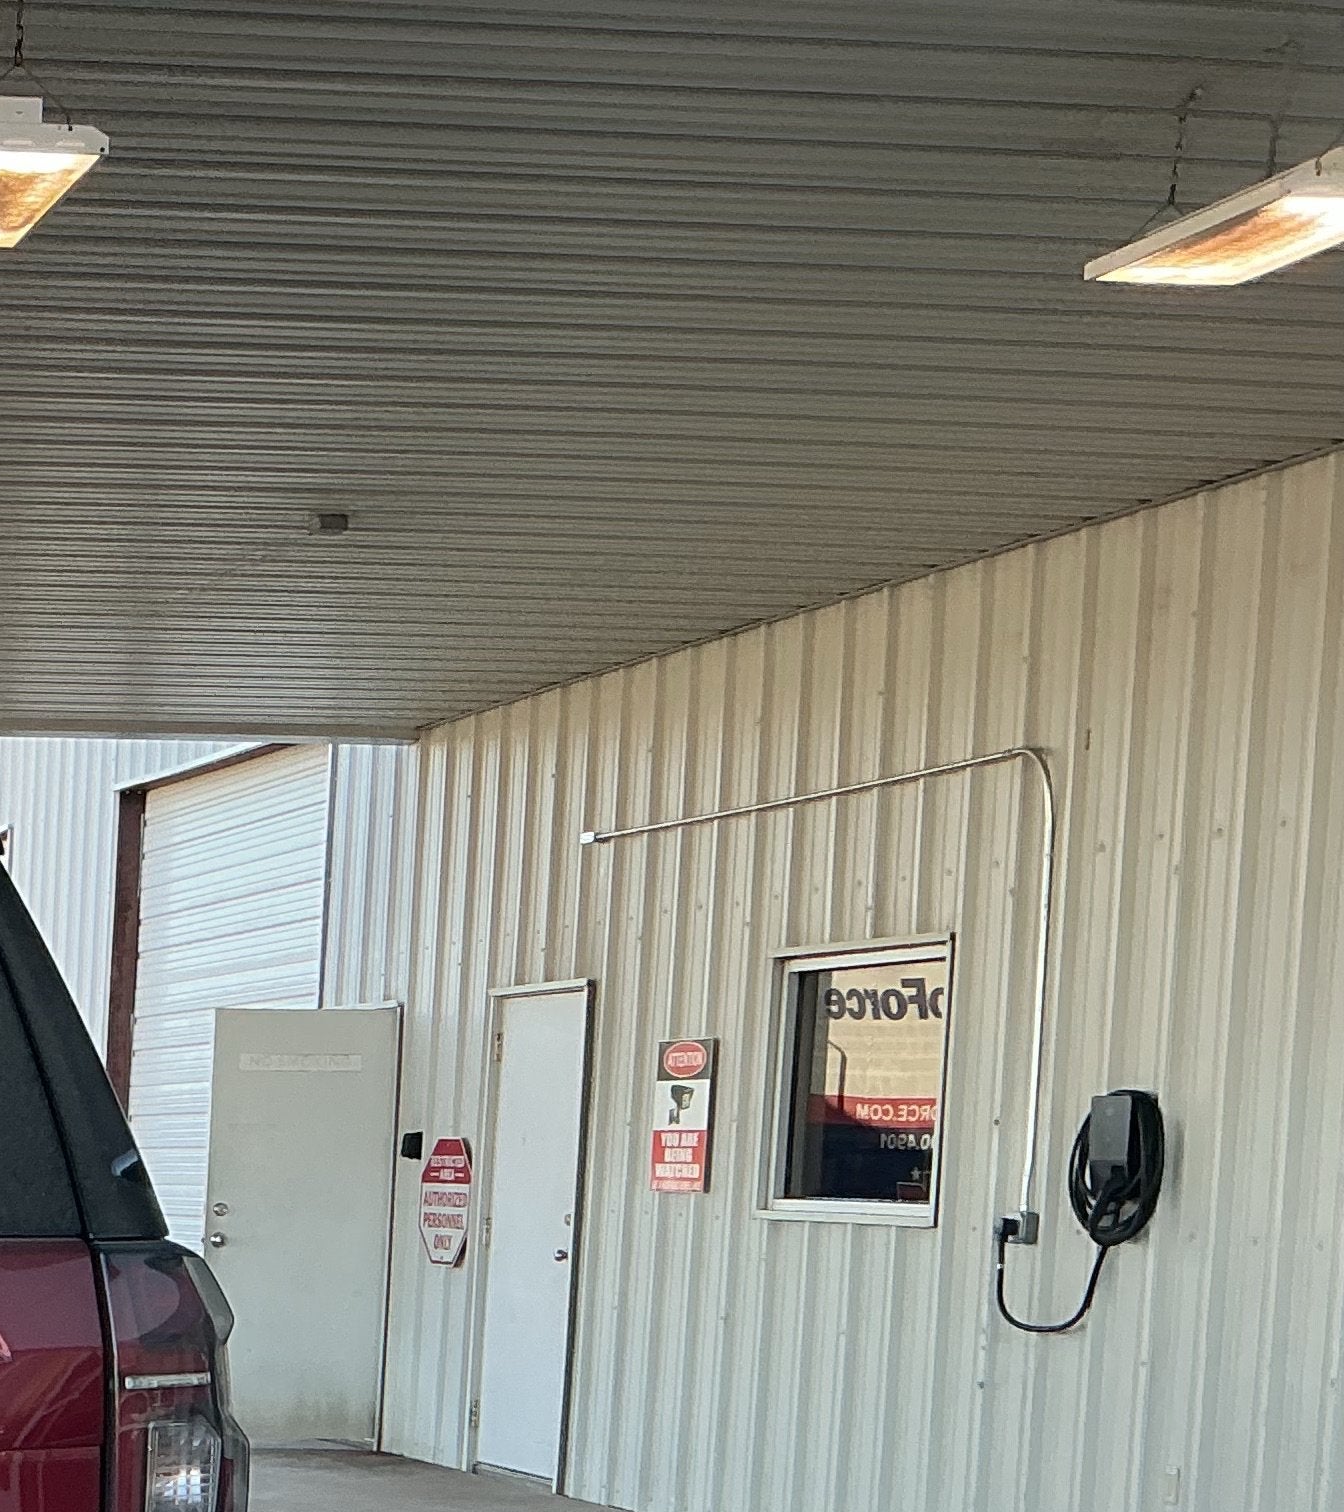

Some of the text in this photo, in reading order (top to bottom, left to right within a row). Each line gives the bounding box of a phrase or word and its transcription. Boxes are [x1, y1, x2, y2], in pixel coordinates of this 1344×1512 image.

[661, 1132, 699, 1147] YOU ARE
[664, 1148, 692, 1162] BEING
[423, 1191, 467, 1208] AUTHORIZED
[423, 1211, 464, 1230] PERSONNEL
[434, 1233, 453, 1251] ONLY
